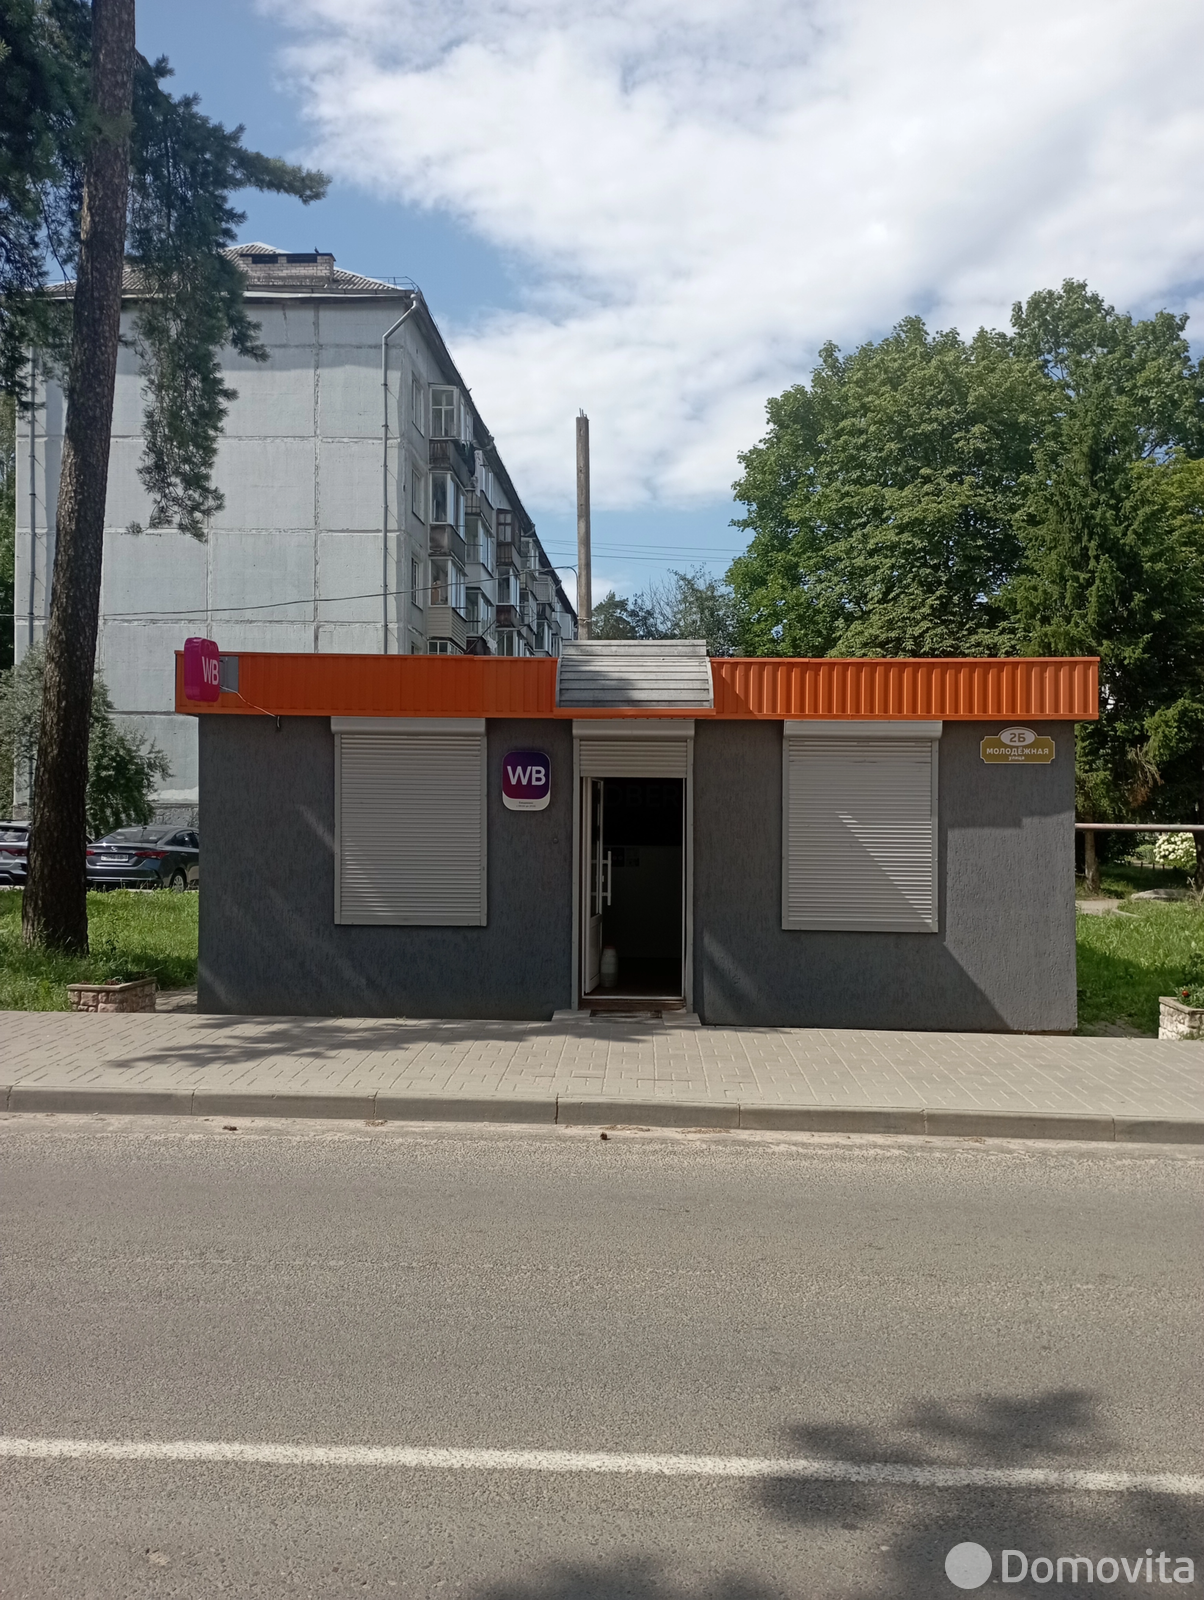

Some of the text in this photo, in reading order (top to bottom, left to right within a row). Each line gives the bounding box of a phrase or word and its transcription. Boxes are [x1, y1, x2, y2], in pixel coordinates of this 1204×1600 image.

[201, 656, 219, 685] WB
[1009, 733, 1026, 743] 2Б
[986, 747, 1049, 755] МОЛОДЁЖНАЯ
[507, 765, 546, 785] WB
